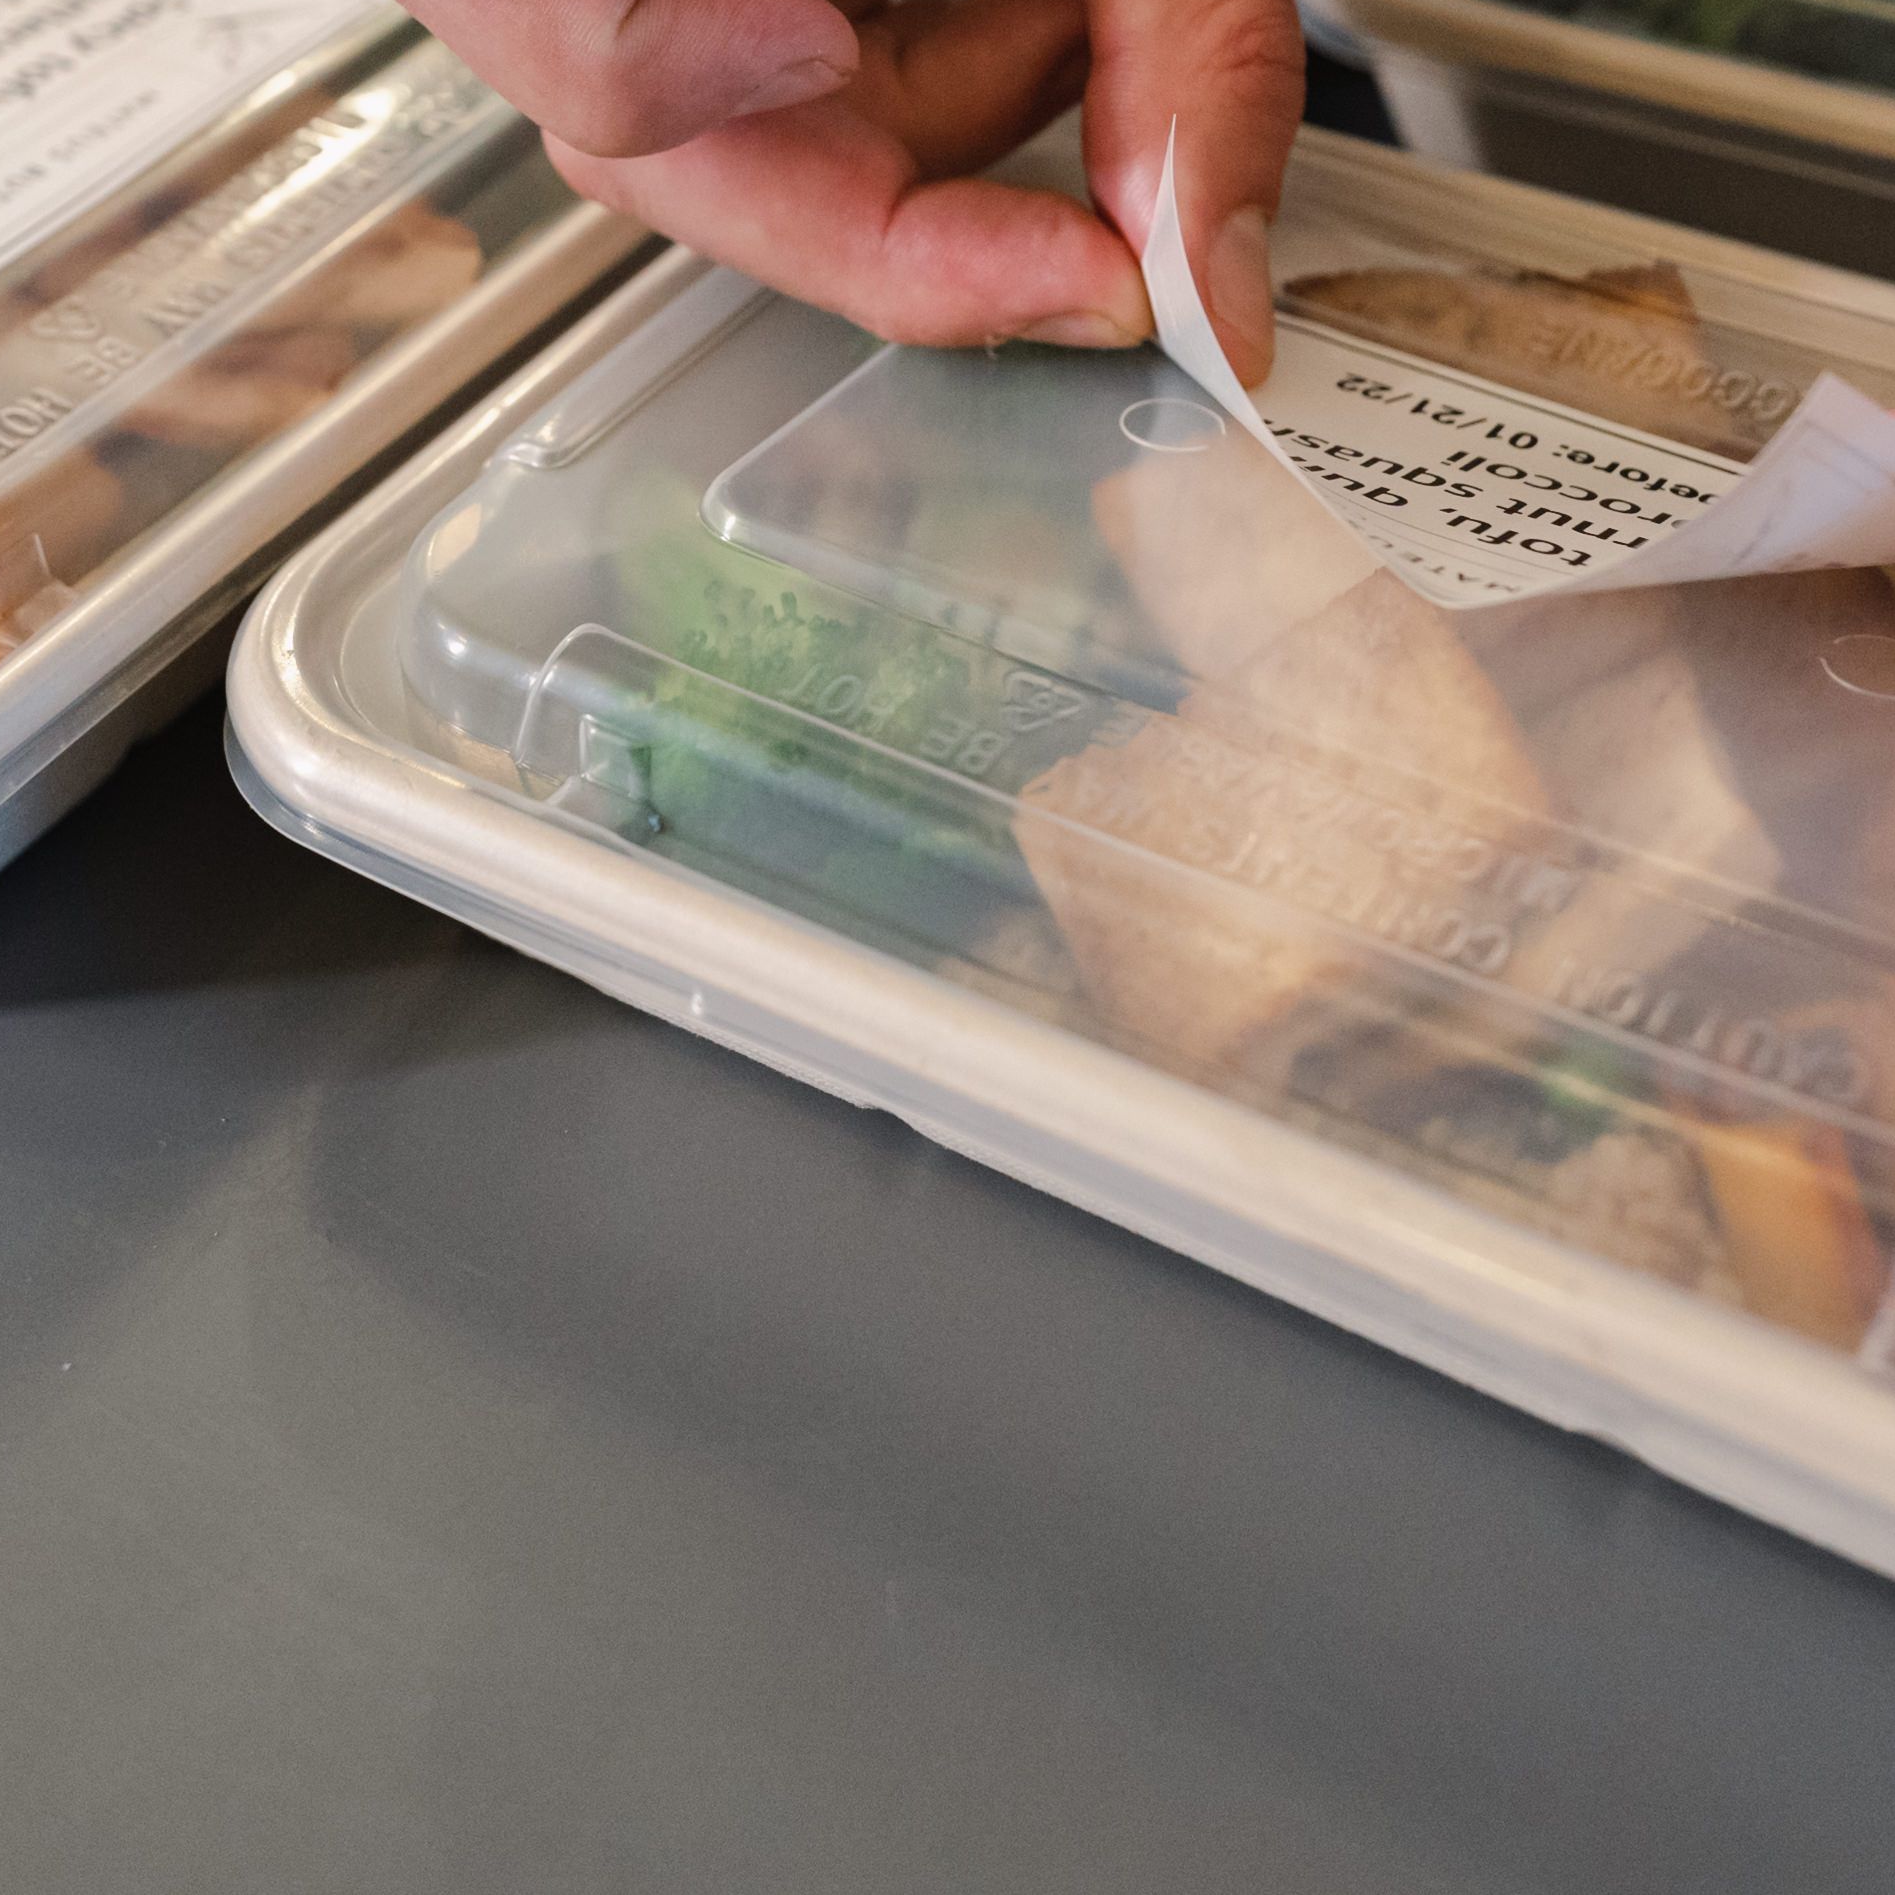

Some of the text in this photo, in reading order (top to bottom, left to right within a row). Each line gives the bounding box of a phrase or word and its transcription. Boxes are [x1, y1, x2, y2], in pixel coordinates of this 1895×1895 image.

[69, 334, 139, 389] BE
[1334, 371, 1539, 451] 01/21/22
[1287, 455, 1592, 569] tofu, qui
[774, 659, 897, 741] HOT
[926, 706, 1008, 780] BE
[1161, 811, 1512, 981] CONTENTS
[1553, 952, 1872, 1110] CAUTION
